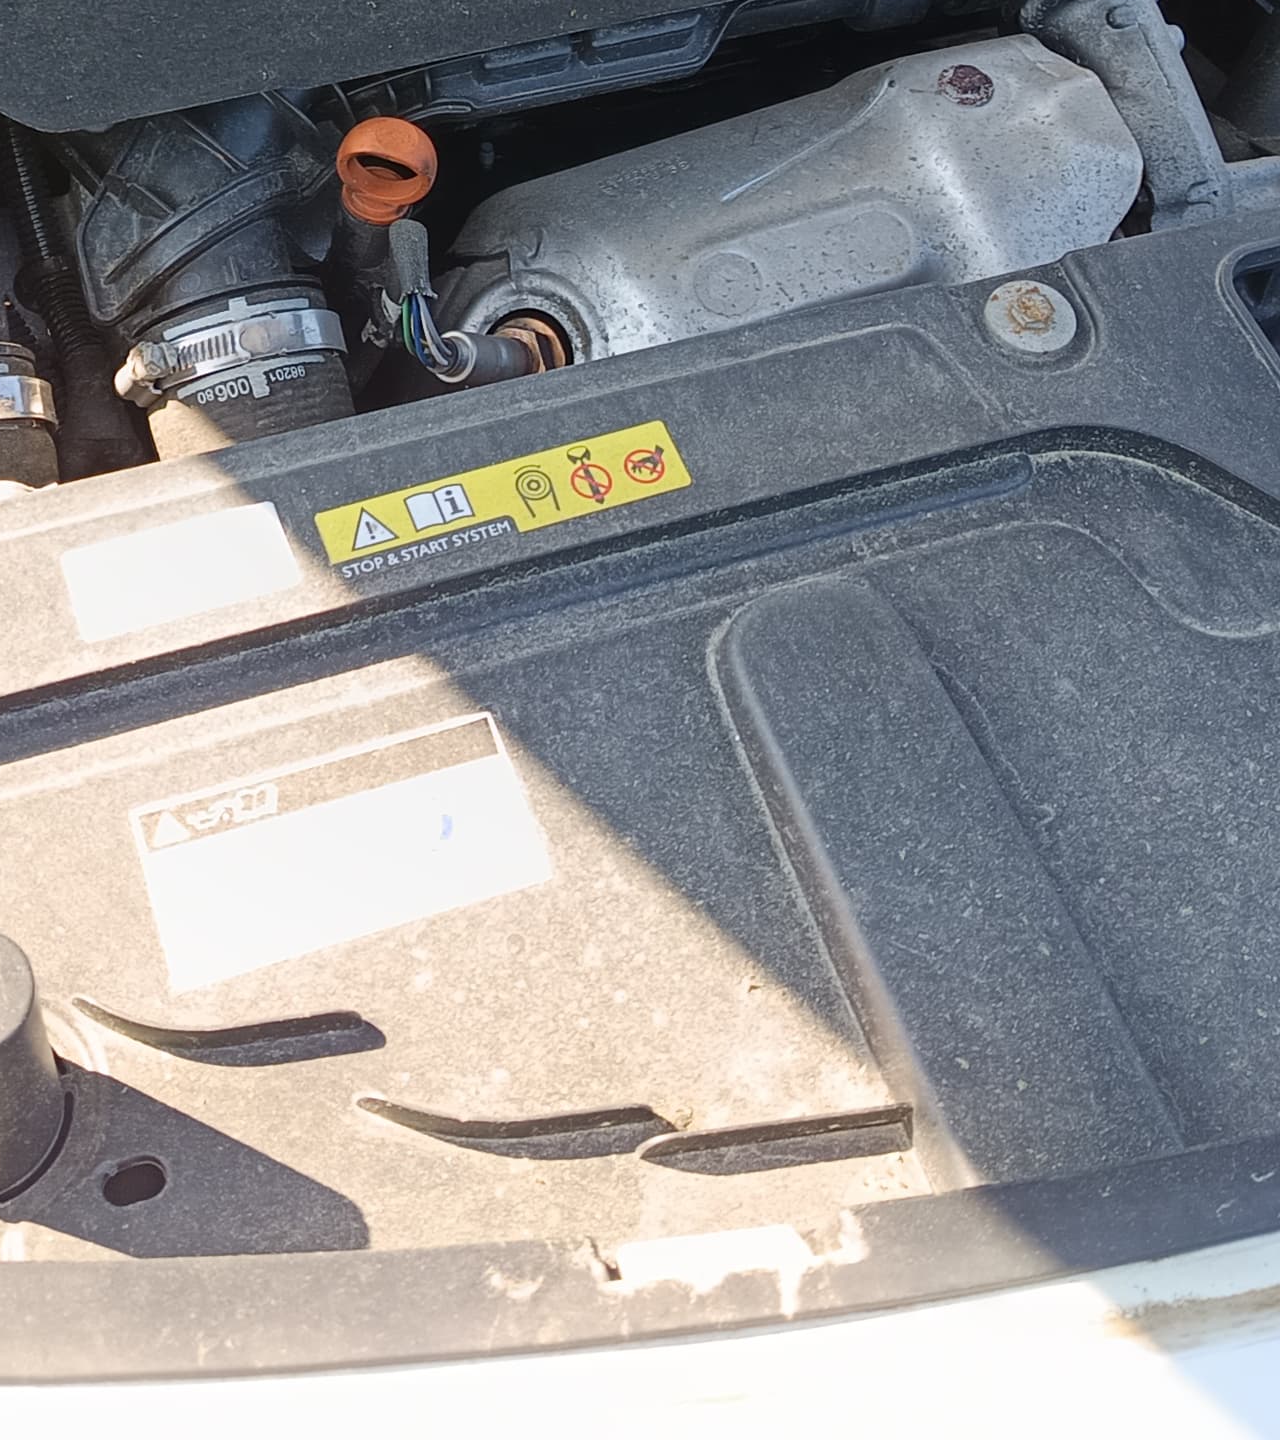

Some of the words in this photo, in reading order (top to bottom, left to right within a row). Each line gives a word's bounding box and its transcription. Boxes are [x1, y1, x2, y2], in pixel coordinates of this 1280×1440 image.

[269, 365, 306, 382] 98201
[197, 378, 250, 405] 00680
[341, 557, 384, 578] STOP
[387, 552, 400, 567] &
[400, 536, 450, 562] START
[453, 519, 512, 548] SYSTEM
